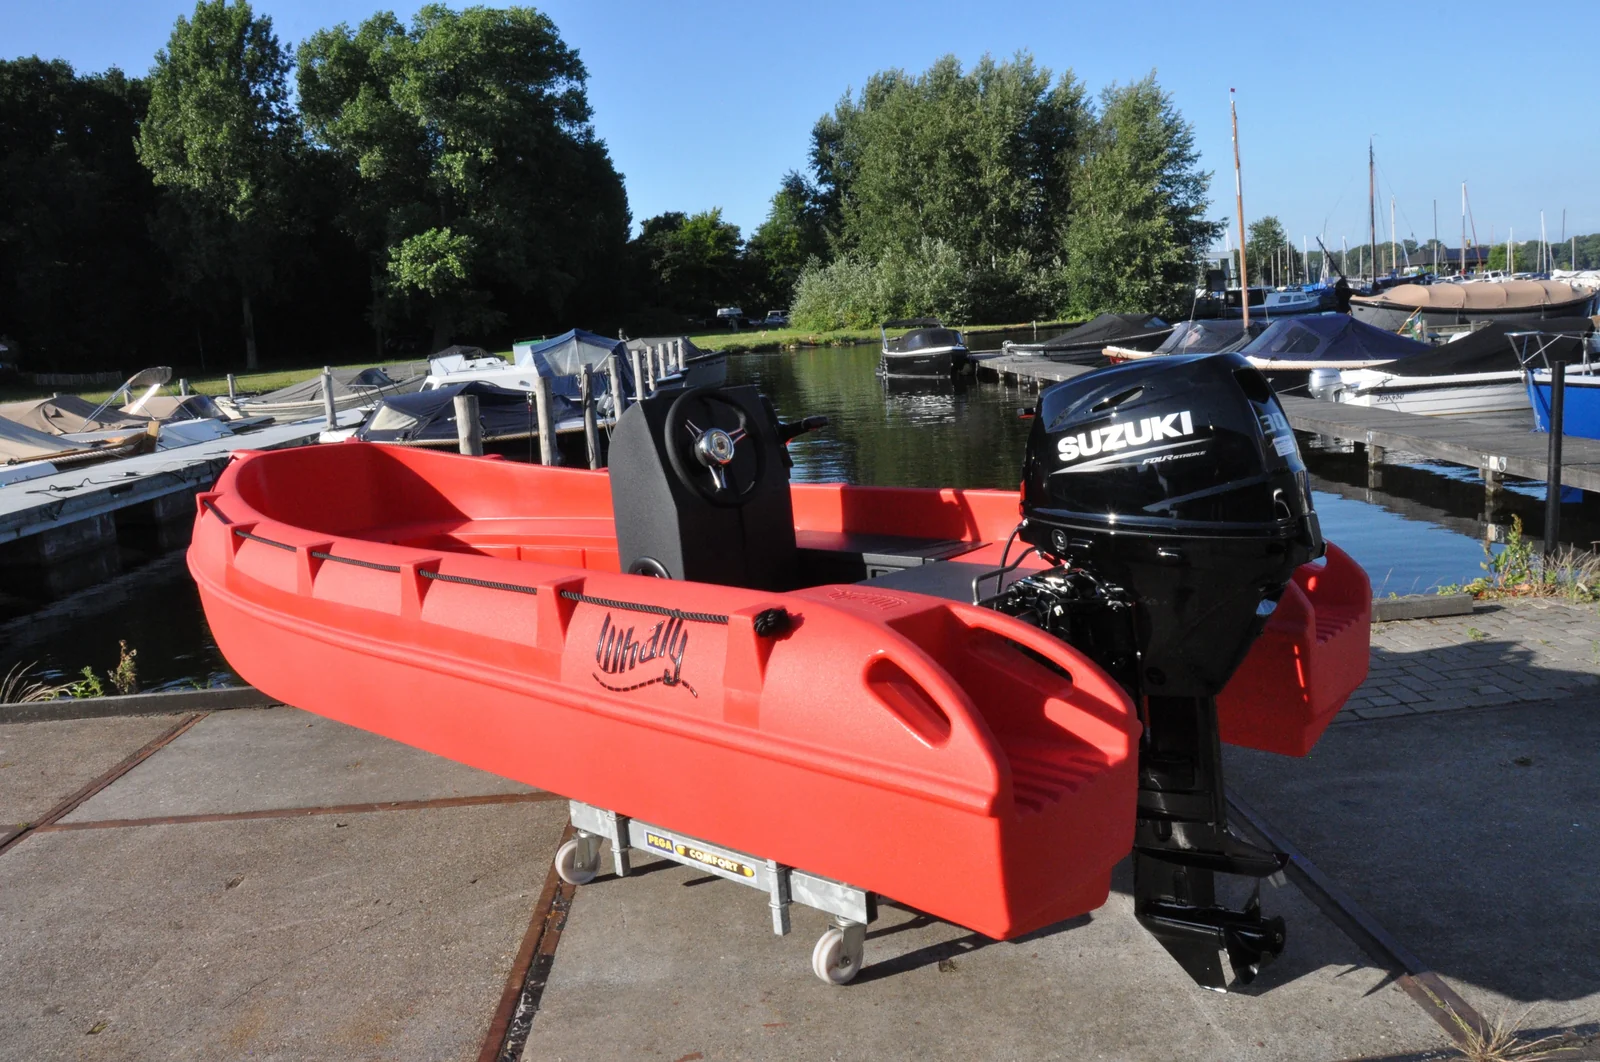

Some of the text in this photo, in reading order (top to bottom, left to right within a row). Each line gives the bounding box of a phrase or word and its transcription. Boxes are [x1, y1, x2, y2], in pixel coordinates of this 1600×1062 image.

[1259, 412, 1287, 434] 30
[1057, 410, 1194, 461] SUZUKI
[596, 611, 689, 687] Whaly
[647, 834, 673, 851] PEGA
[689, 848, 739, 872] COMFORT
